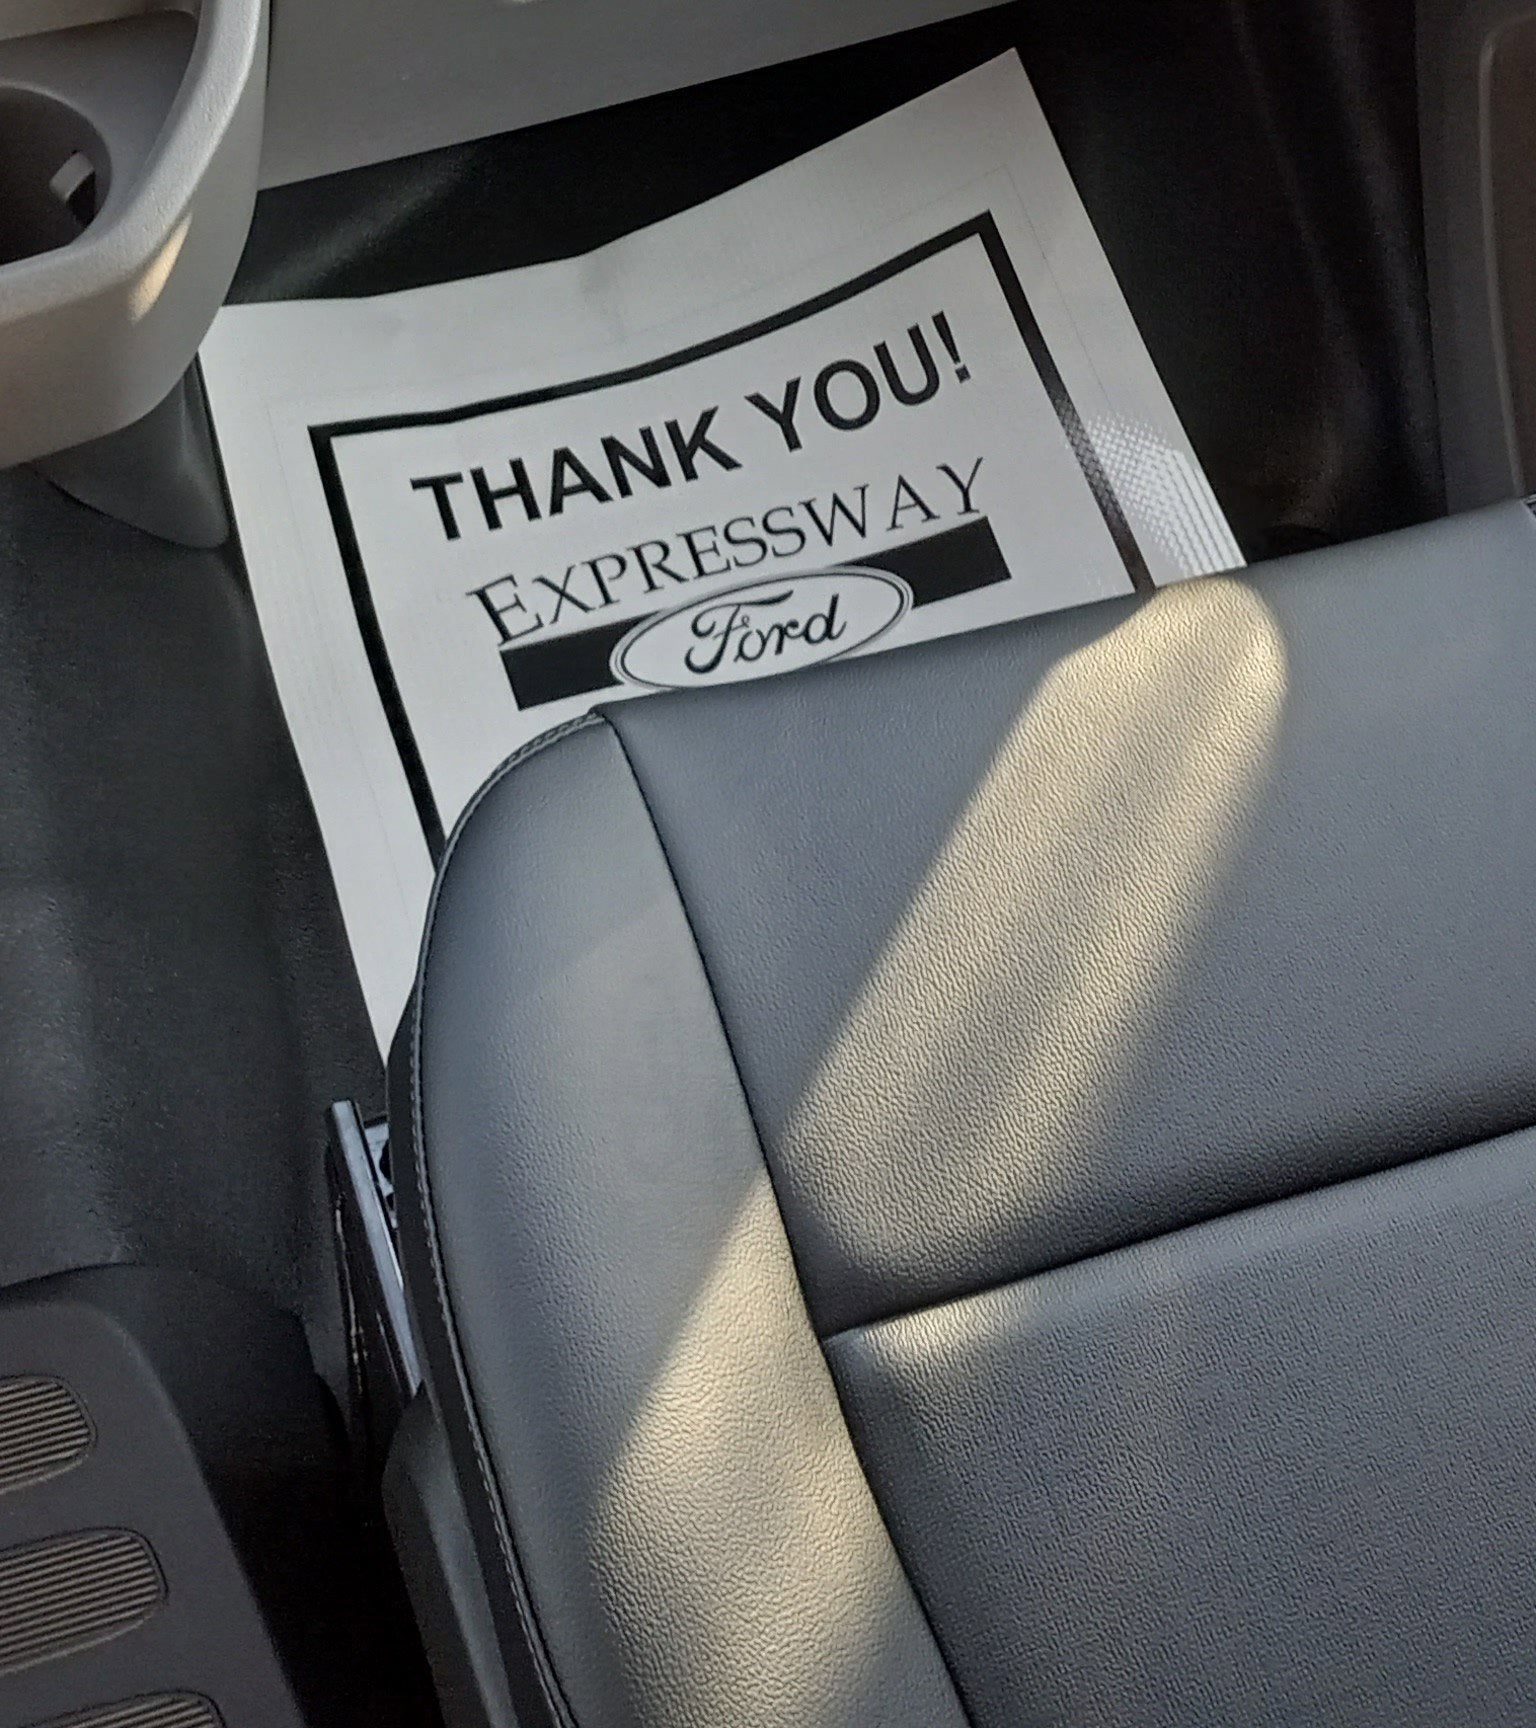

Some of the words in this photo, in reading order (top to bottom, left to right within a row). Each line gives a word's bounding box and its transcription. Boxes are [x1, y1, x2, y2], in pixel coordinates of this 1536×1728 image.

[410, 406, 743, 542] THANK
[746, 311, 972, 453] YOU!
[466, 457, 988, 645] EXPRESSWAY
[684, 590, 848, 674] Ford
